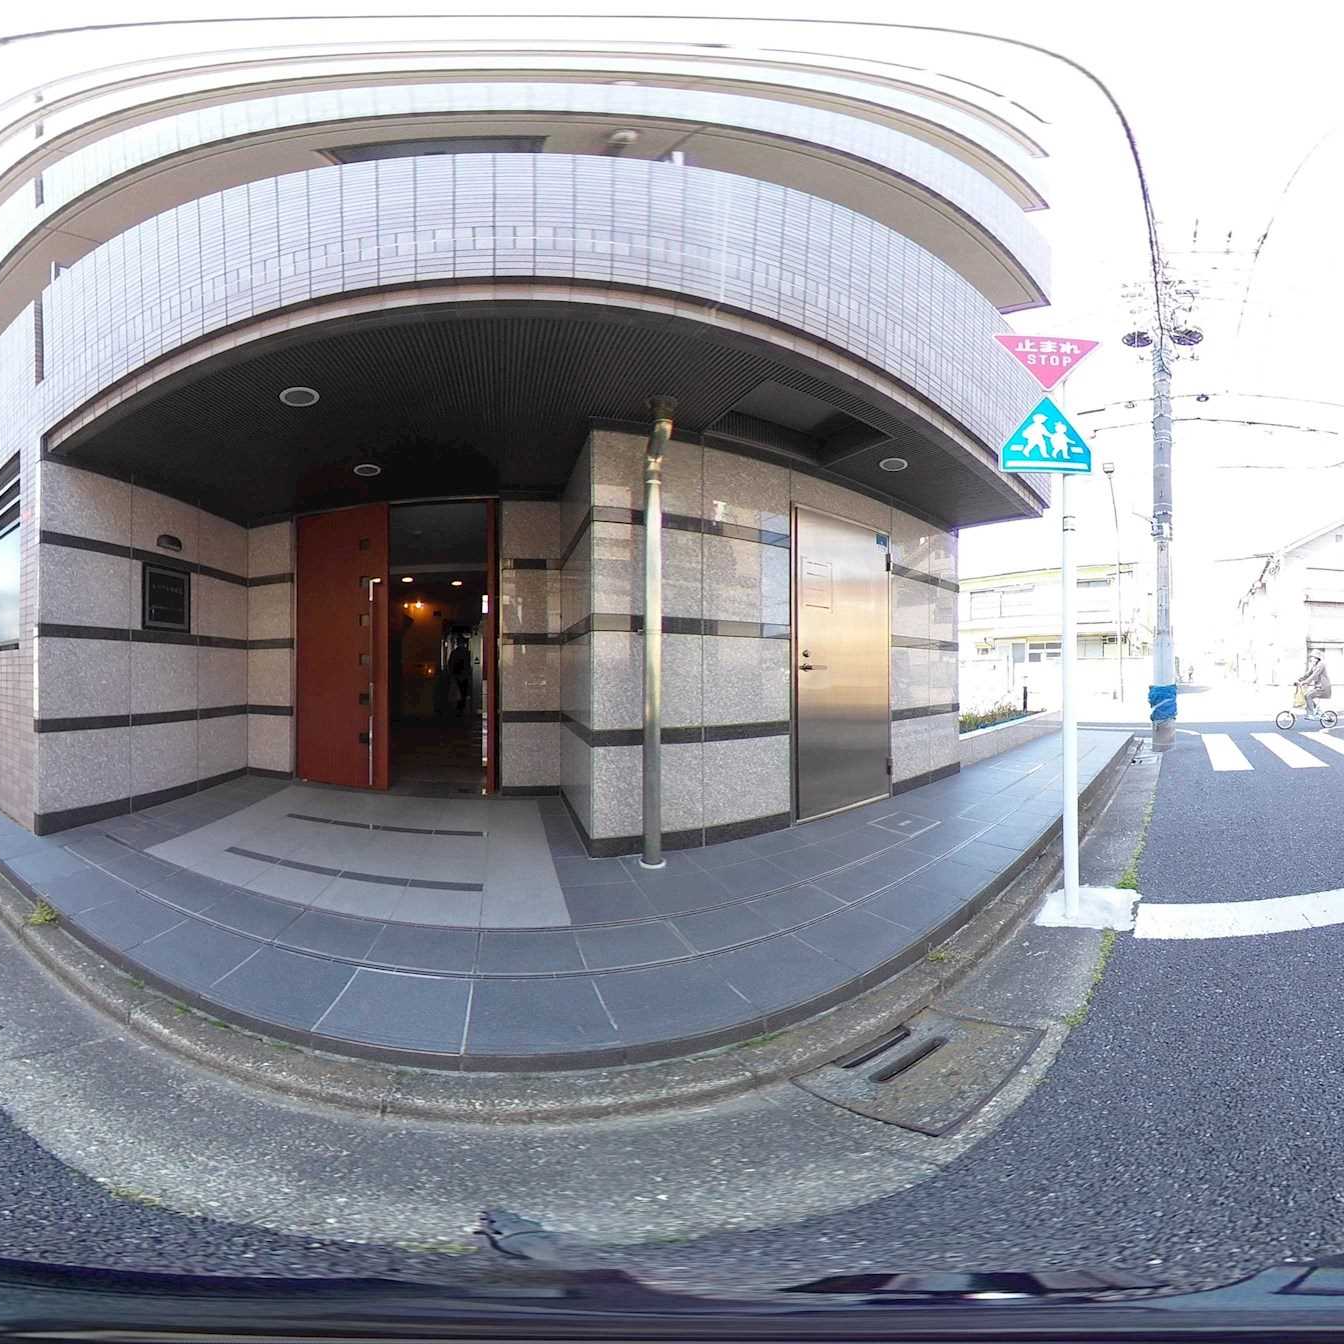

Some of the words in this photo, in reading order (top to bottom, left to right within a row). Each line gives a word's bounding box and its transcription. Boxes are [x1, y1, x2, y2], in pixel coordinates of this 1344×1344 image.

[1014, 339, 1081, 354] 止まれ
[1027, 353, 1072, 367] STOP
